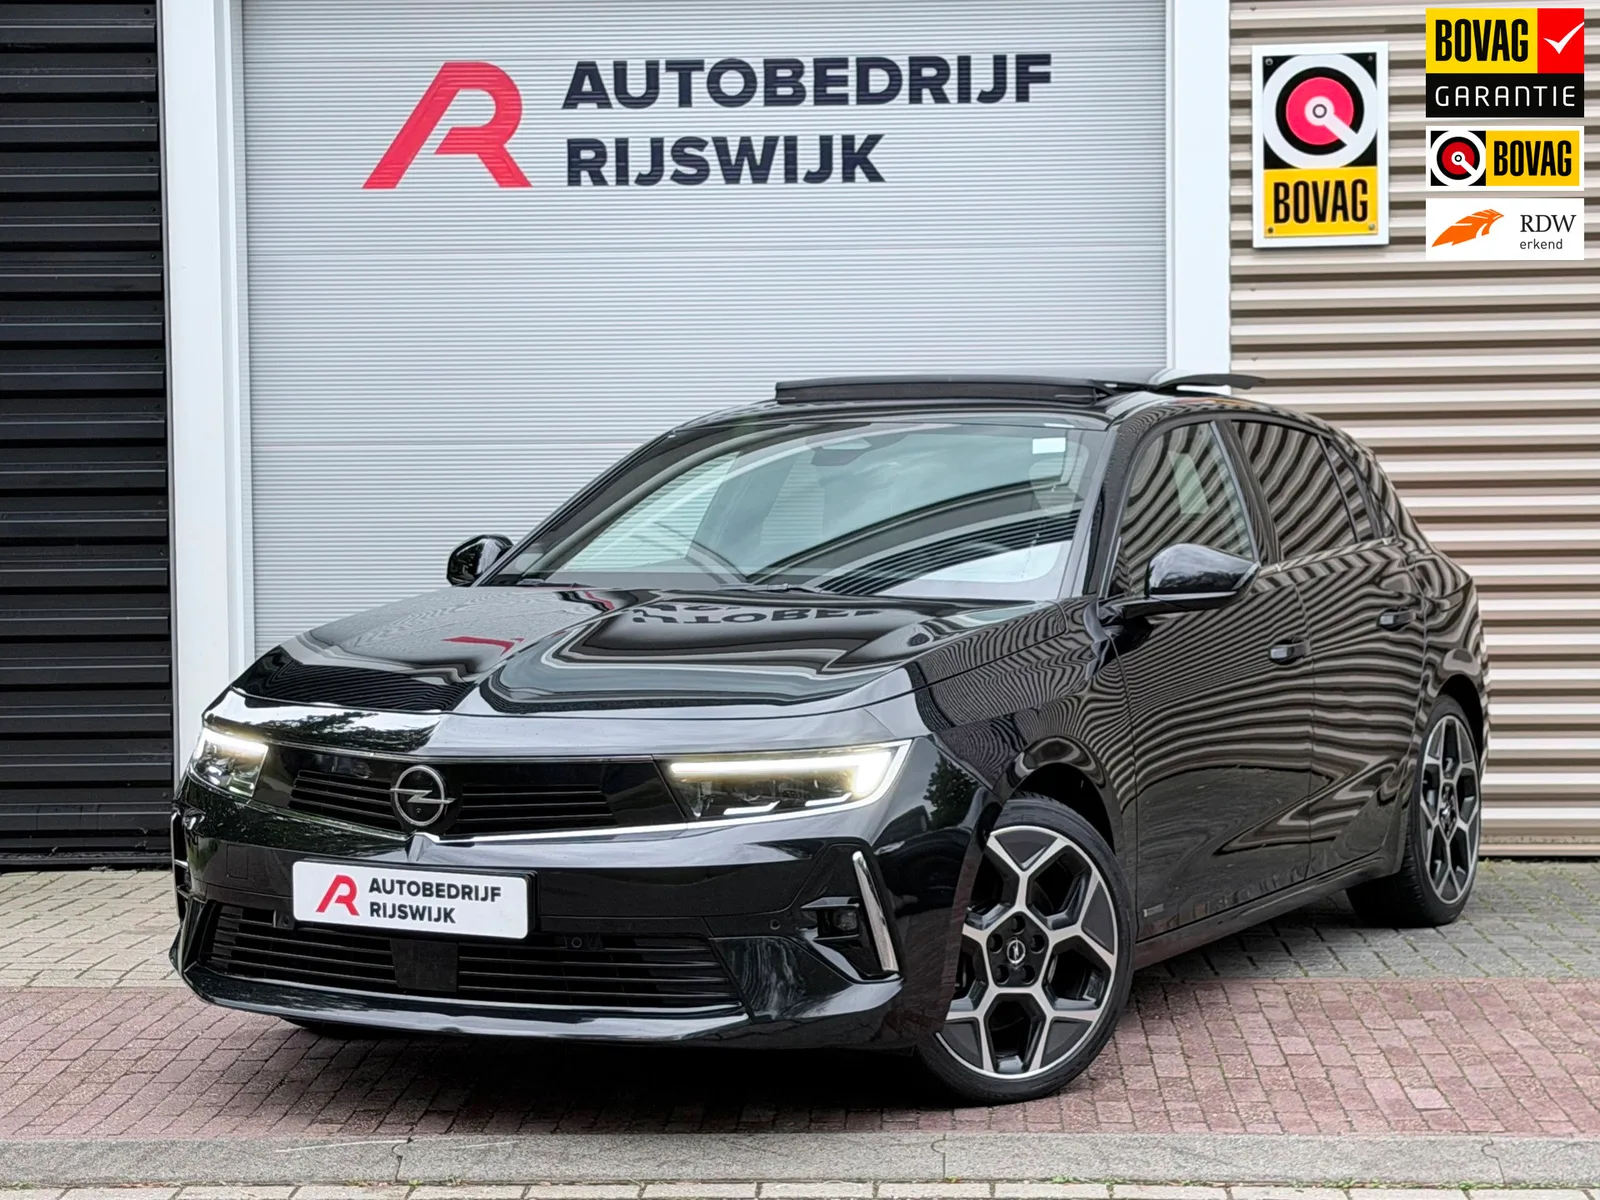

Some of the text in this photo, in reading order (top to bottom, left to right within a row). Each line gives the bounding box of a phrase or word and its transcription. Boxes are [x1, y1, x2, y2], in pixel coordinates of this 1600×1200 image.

[561, 53, 1052, 109] AUTOBEDRIJF
[566, 134, 885, 187] RIJSWIJK
[1273, 178, 1369, 224] BOVAG
[368, 877, 502, 903] AUTOBEDRIJF
[369, 901, 457, 924] RIJSWIJK
